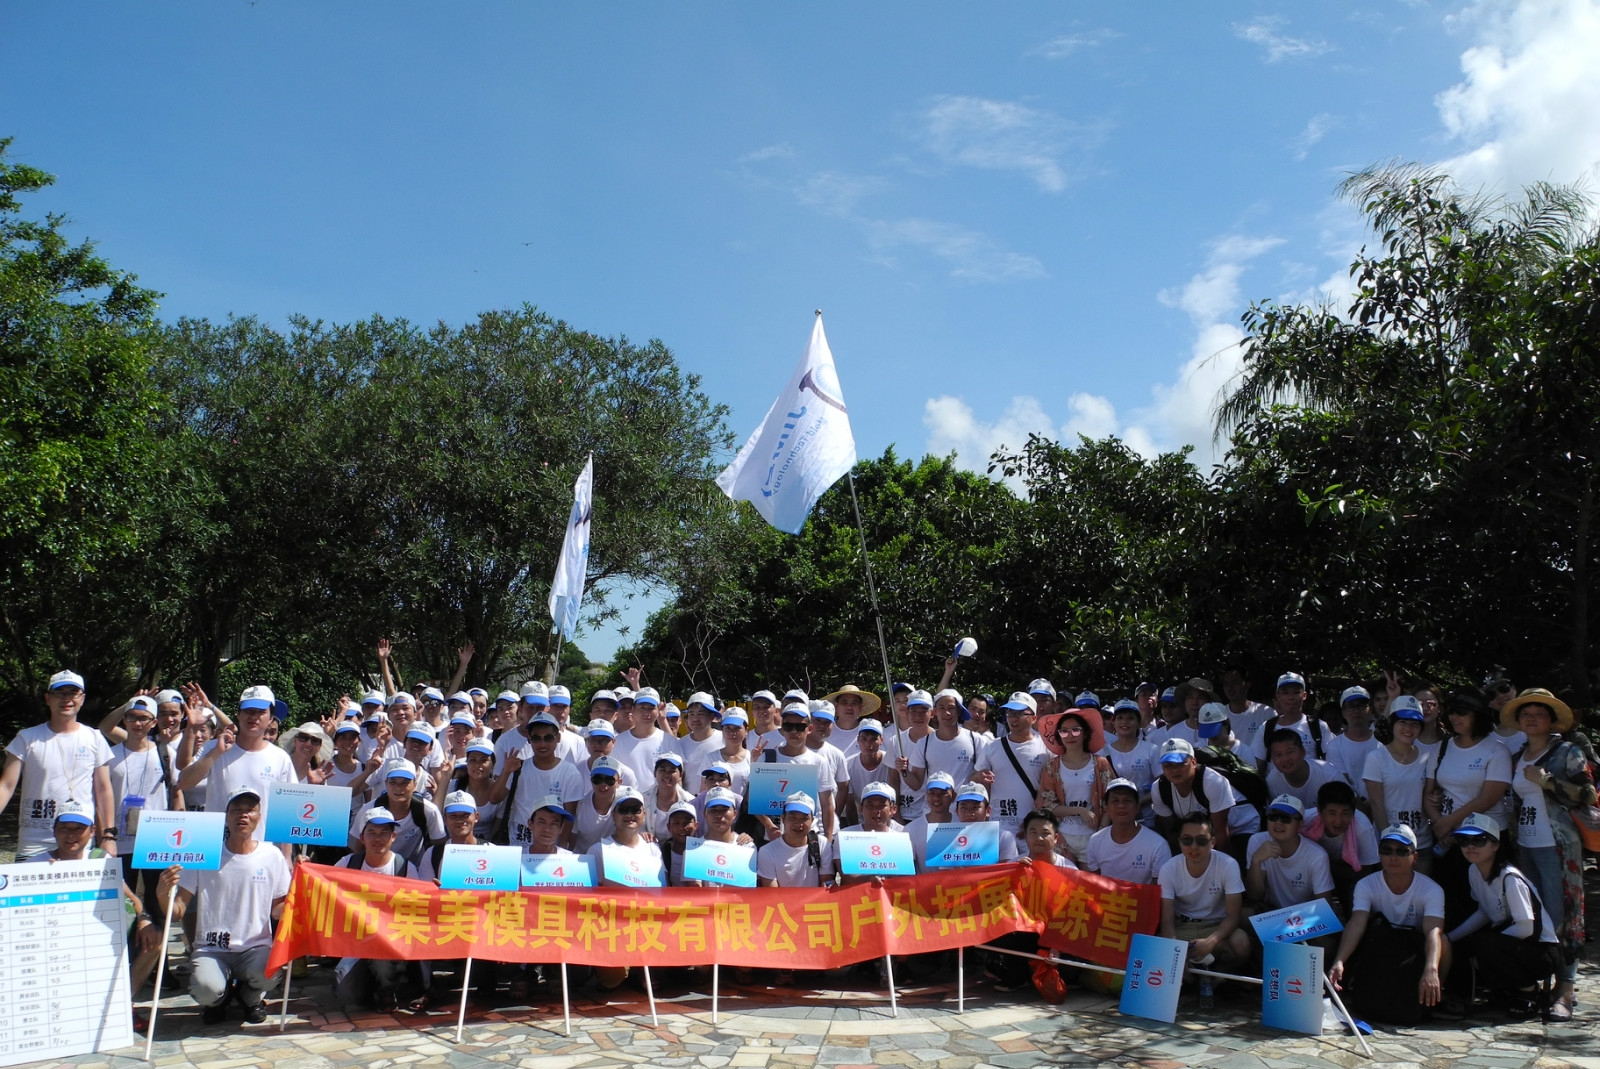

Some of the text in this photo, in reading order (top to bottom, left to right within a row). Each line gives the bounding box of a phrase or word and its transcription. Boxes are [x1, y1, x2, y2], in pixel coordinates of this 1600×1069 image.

[779, 781, 788, 792] 7
[31, 799, 56, 818] 坚持
[303, 804, 315, 819] 2
[1000, 799, 1018, 816] 坚持
[291, 826, 323, 838] 风火队
[172, 830, 183, 846] 1
[958, 836, 967, 846] 9
[871, 846, 881, 856] 8
[148, 852, 206, 863] 勇往直前队
[716, 855, 726, 865] 6
[944, 853, 981, 861] 快乐团队
[476, 859, 487, 870] 3
[630, 861, 640, 872] 5
[860, 861, 897, 870] 黄金战队
[12, 868, 117, 882] 深圳市集美模具科技有限公司
[552, 866, 564, 877] 4
[464, 876, 496, 885] 小强队
[1285, 916, 1303, 926] 12
[206, 931, 230, 949] 坚持
[1130, 958, 1144, 990] 勇士队
[1147, 968, 1164, 985] 10
[1270, 968, 1280, 1002] 梦想队
[1288, 978, 1302, 994] 11
